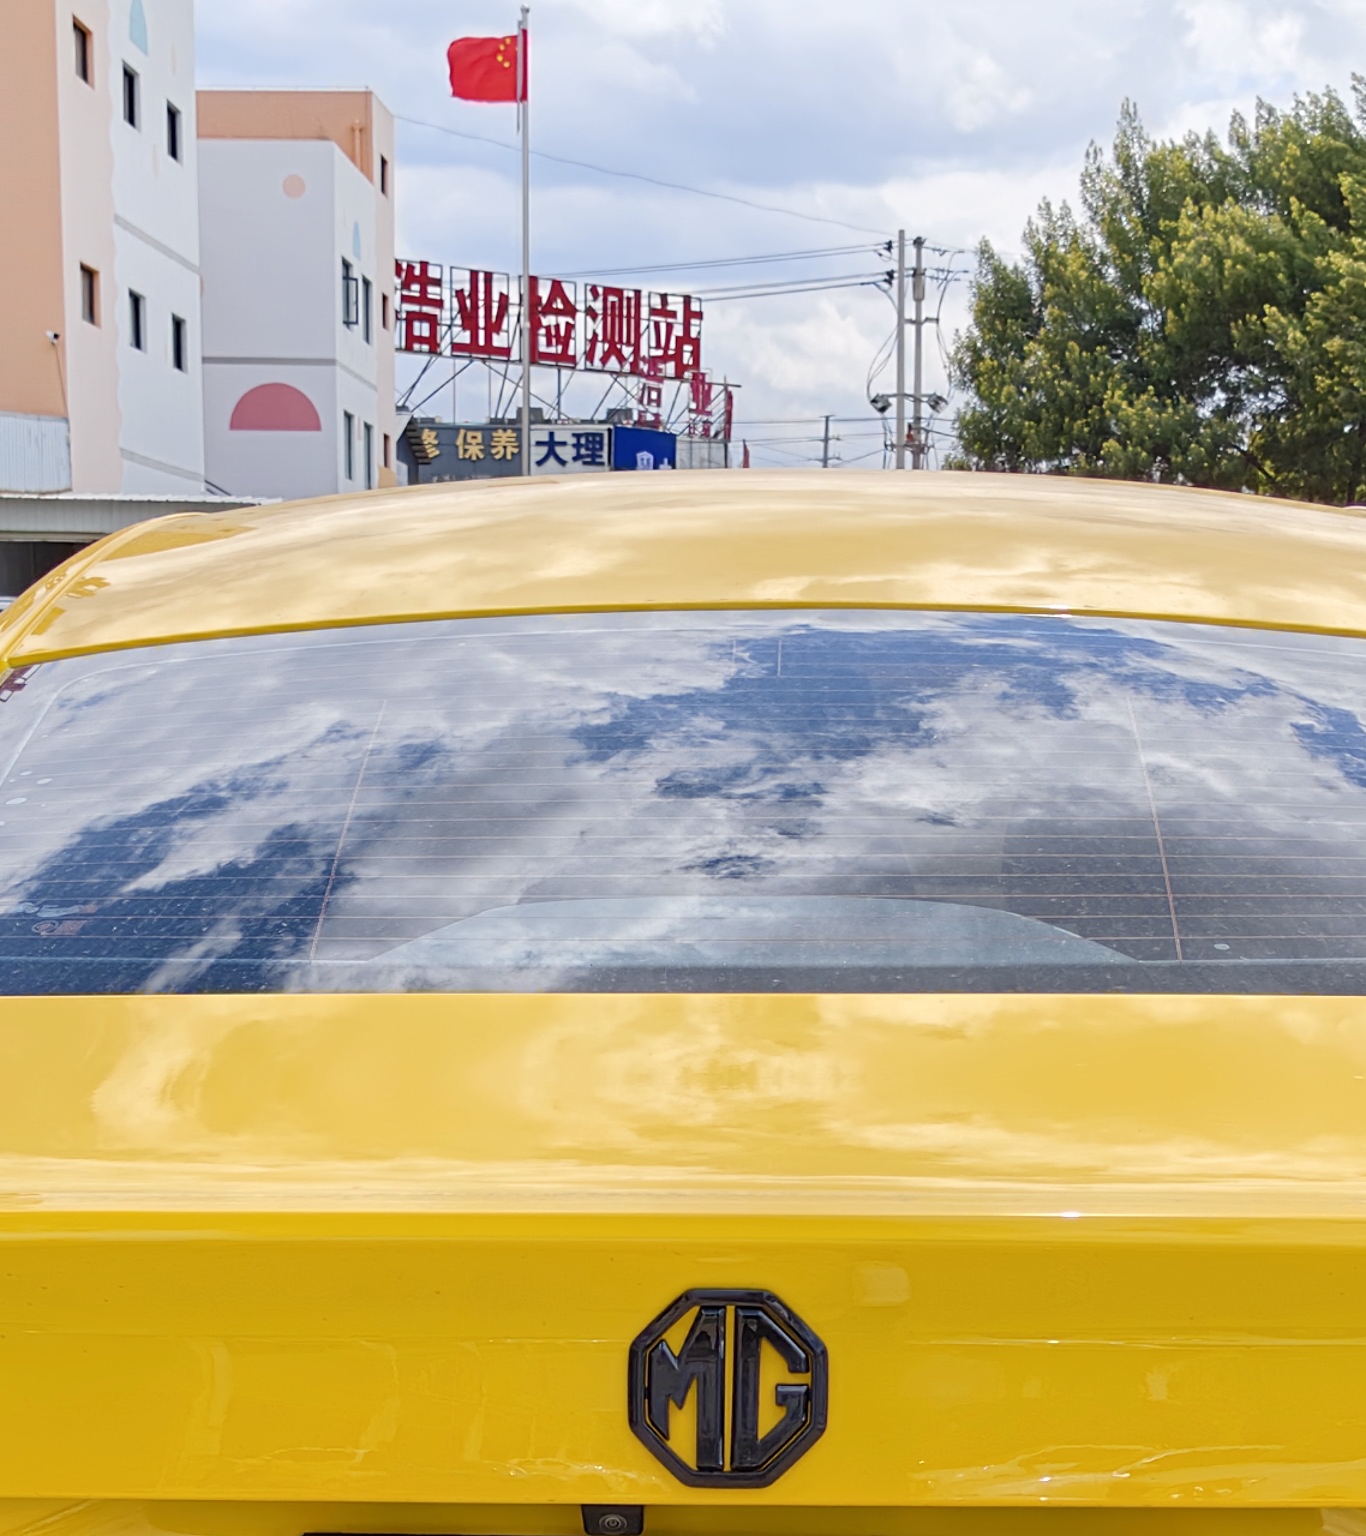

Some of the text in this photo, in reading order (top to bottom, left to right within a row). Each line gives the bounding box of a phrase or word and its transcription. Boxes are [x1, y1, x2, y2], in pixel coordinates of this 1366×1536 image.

[455, 428, 520, 461] 保养
[535, 431, 606, 467] 大理
[644, 1303, 813, 1473] MG
